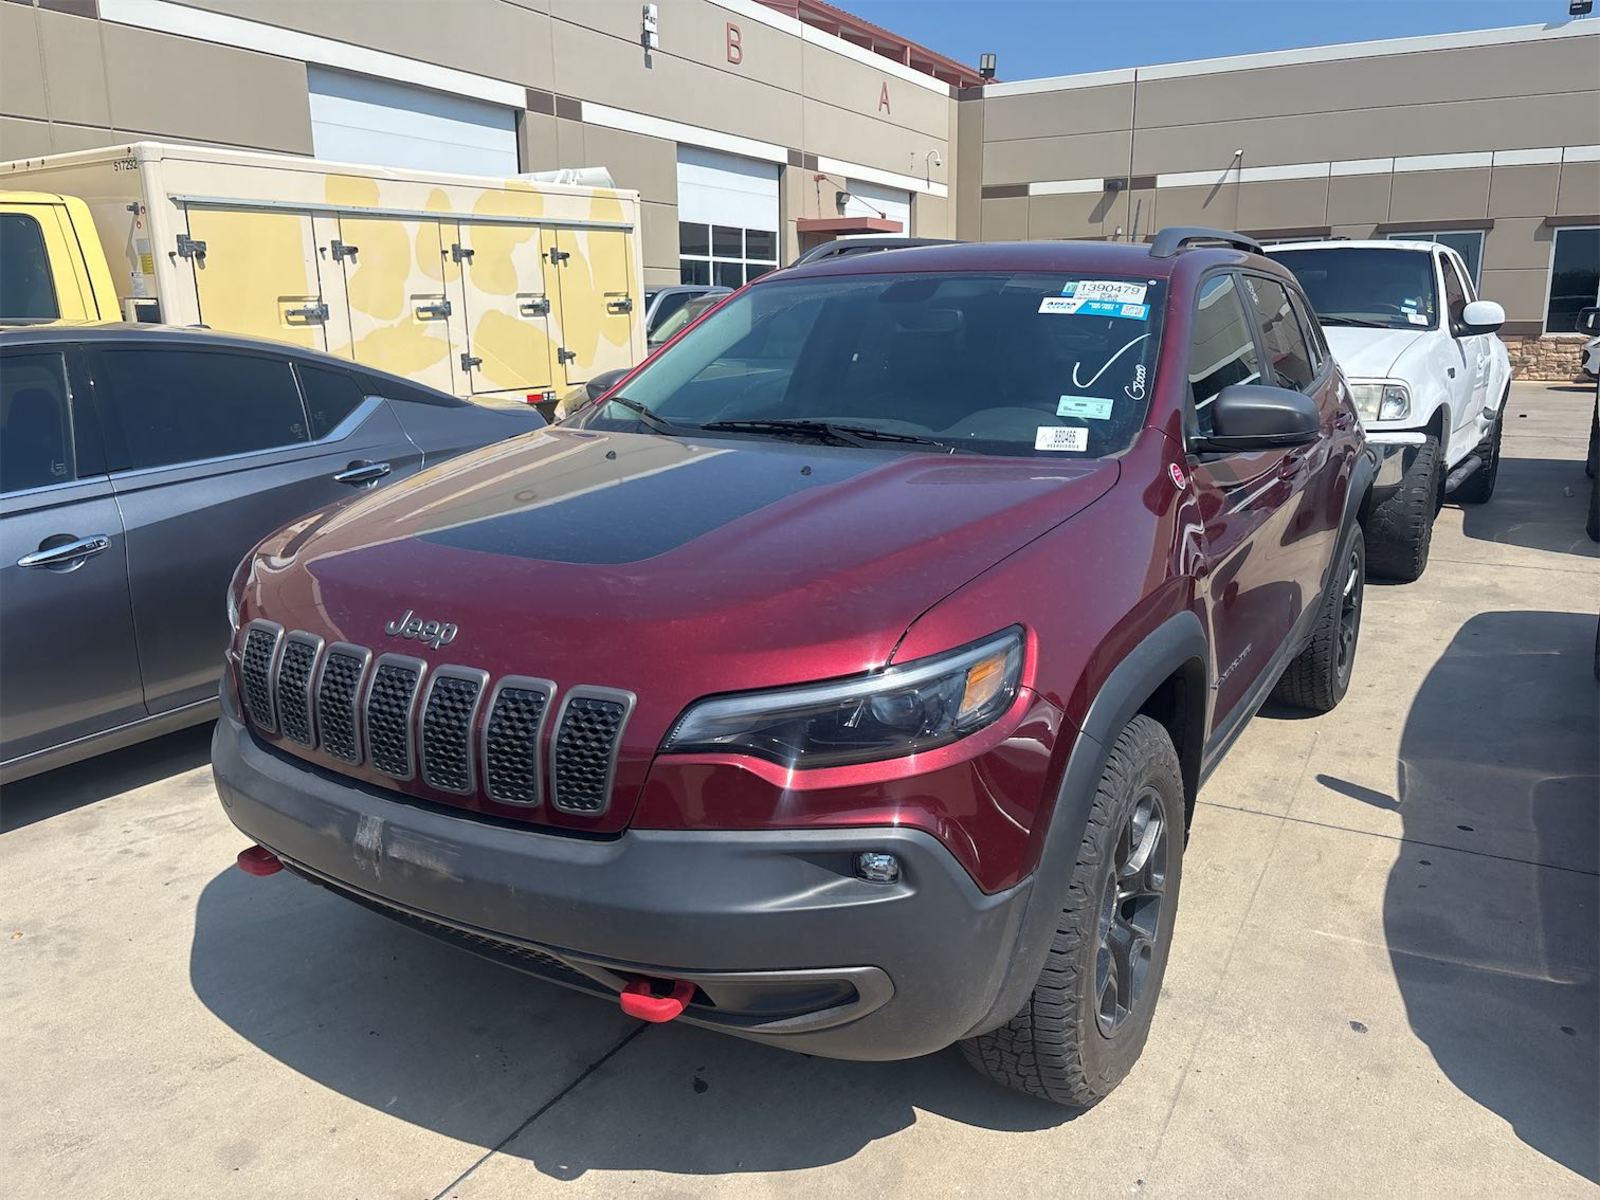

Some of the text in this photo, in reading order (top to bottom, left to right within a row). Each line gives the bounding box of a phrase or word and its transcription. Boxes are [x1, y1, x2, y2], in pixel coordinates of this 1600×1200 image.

[726, 22, 743, 65] B
[878, 81, 891, 115] A
[1081, 283, 1141, 295] 1390479
[385, 609, 458, 650] Jeep
